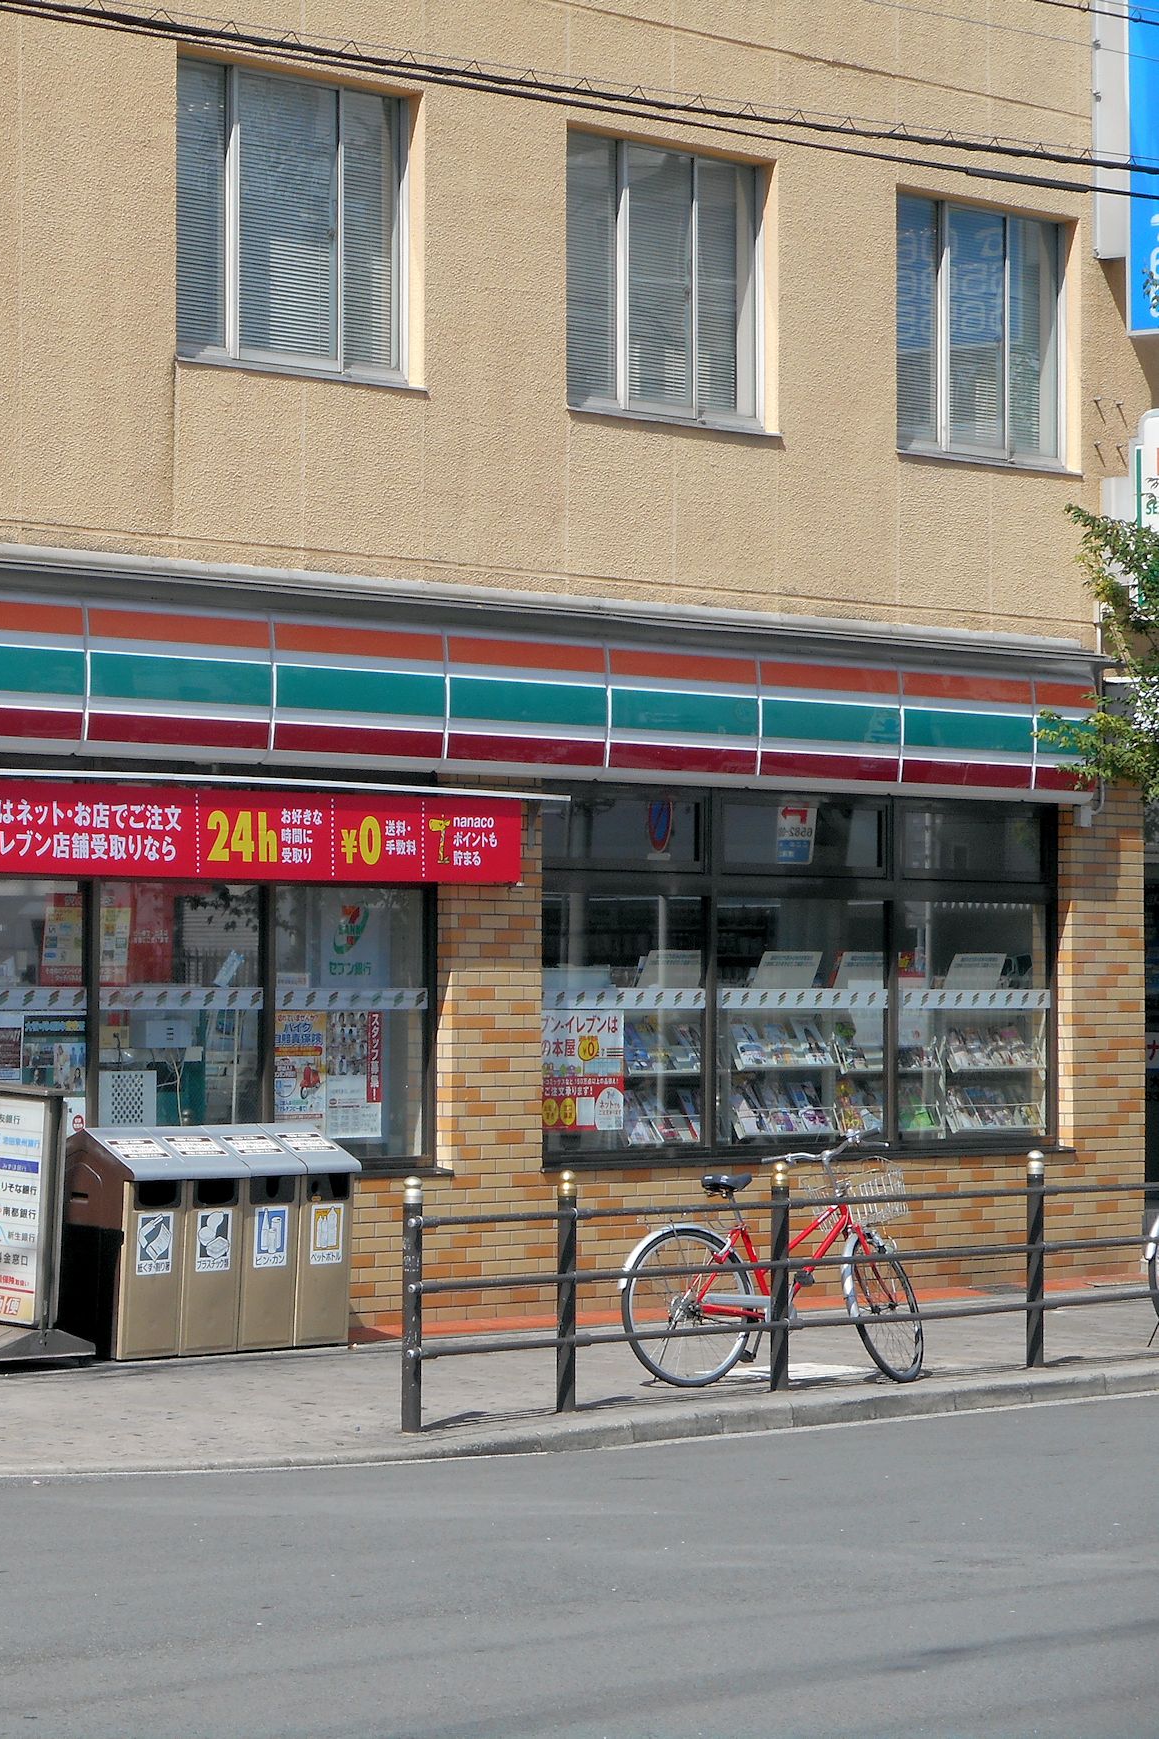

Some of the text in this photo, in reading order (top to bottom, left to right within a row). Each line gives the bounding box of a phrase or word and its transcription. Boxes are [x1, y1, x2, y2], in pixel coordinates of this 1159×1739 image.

[281, 809, 323, 826] お好きな
[453, 816, 494, 829] nanaco
[207, 810, 278, 863] 24h
[281, 828, 313, 844] 時間に
[341, 815, 381, 865] ¥0
[453, 831, 498, 848] ポイントも
[385, 838, 417, 856] 手数料
[281, 846, 312, 864] 受取り
[453, 850, 481, 867] 貯まる
[329, 961, 372, 976] セブン銀行
[284, 1022, 312, 1033] バイク
[1, 1182, 37, 1195] りそな銀行
[3, 1206, 37, 1219] 南都銀行
[7, 1231, 36, 1243] 新生銀行
[255, 1254, 285, 1266] ビン・カン
[311, 1251, 341, 1261] ペットボトル
